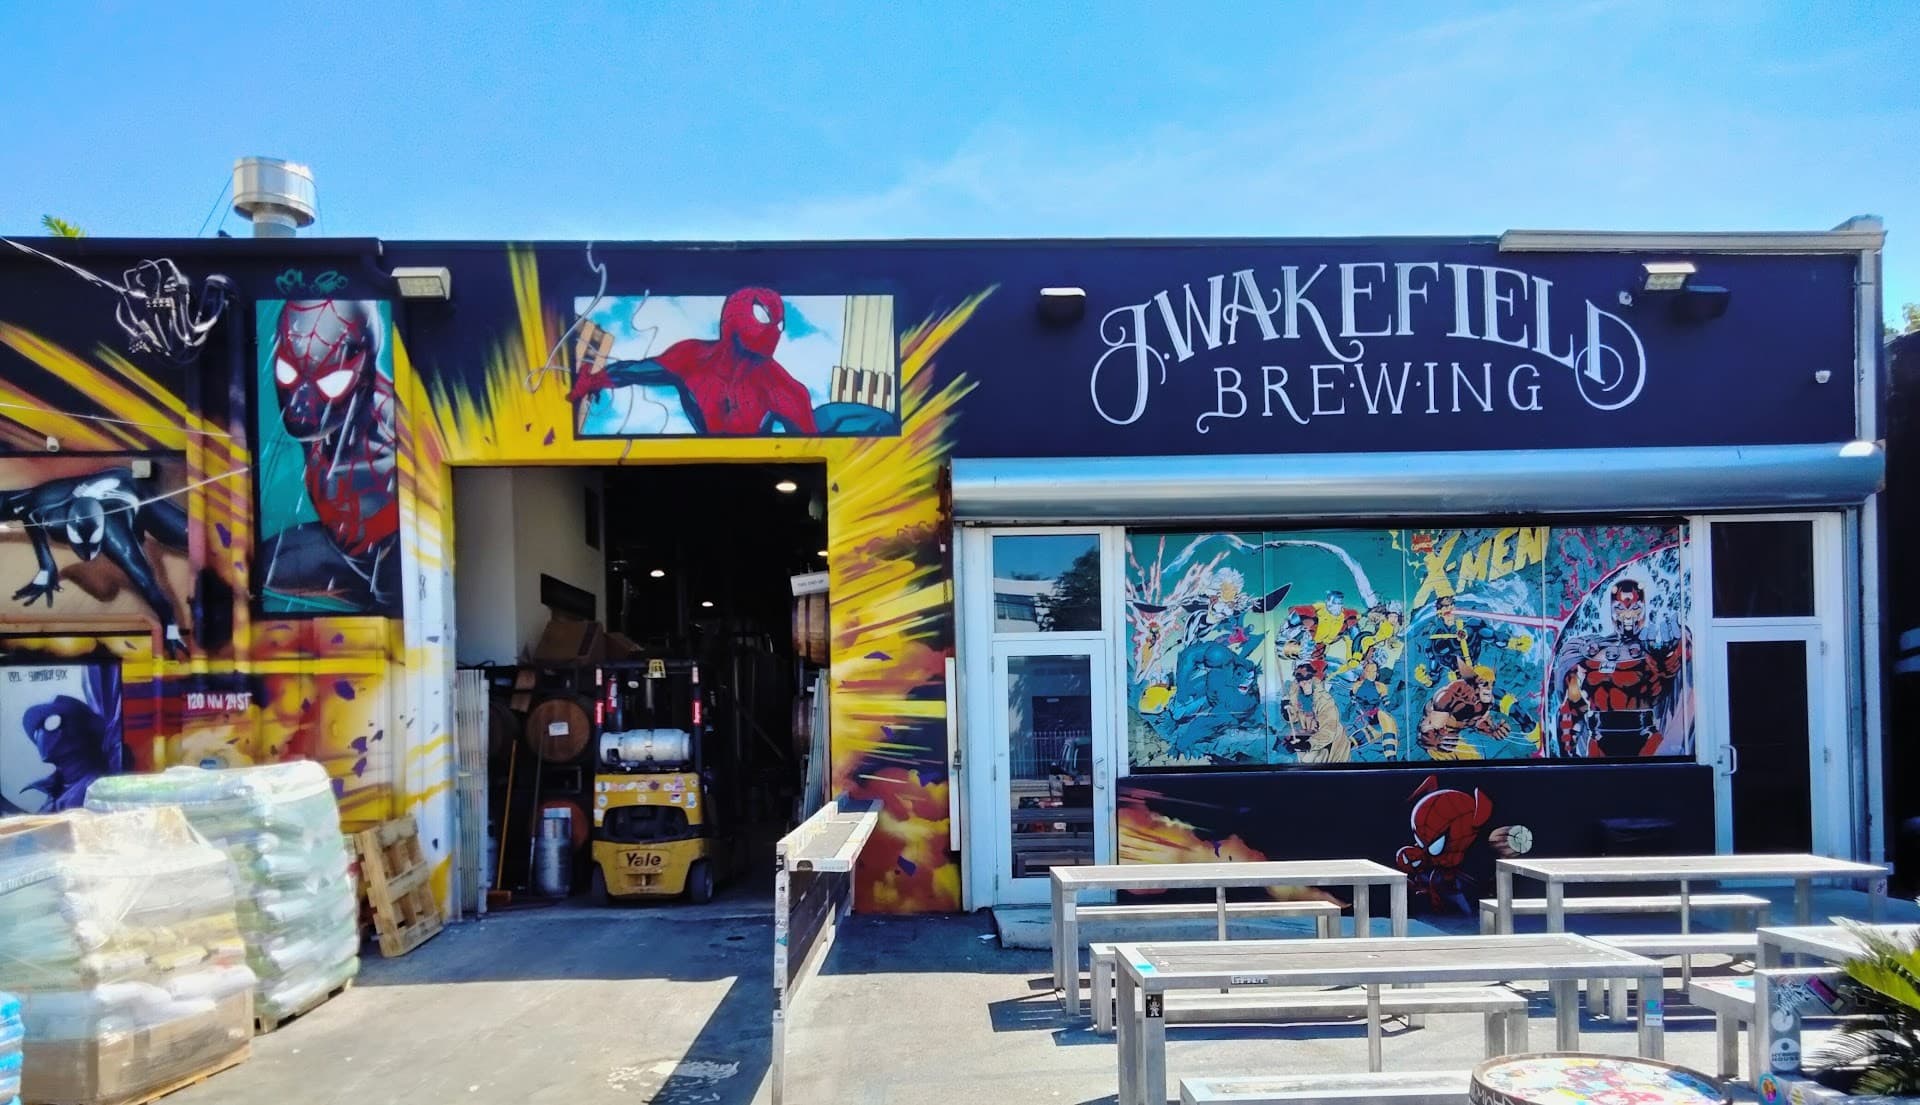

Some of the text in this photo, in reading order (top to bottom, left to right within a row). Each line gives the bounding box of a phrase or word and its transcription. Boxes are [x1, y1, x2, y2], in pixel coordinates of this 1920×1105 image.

[1412, 526, 1549, 609] X-MEN
[187, 693, 205, 710] 120
[207, 694, 223, 709] NW
[625, 852, 662, 867] Yale
